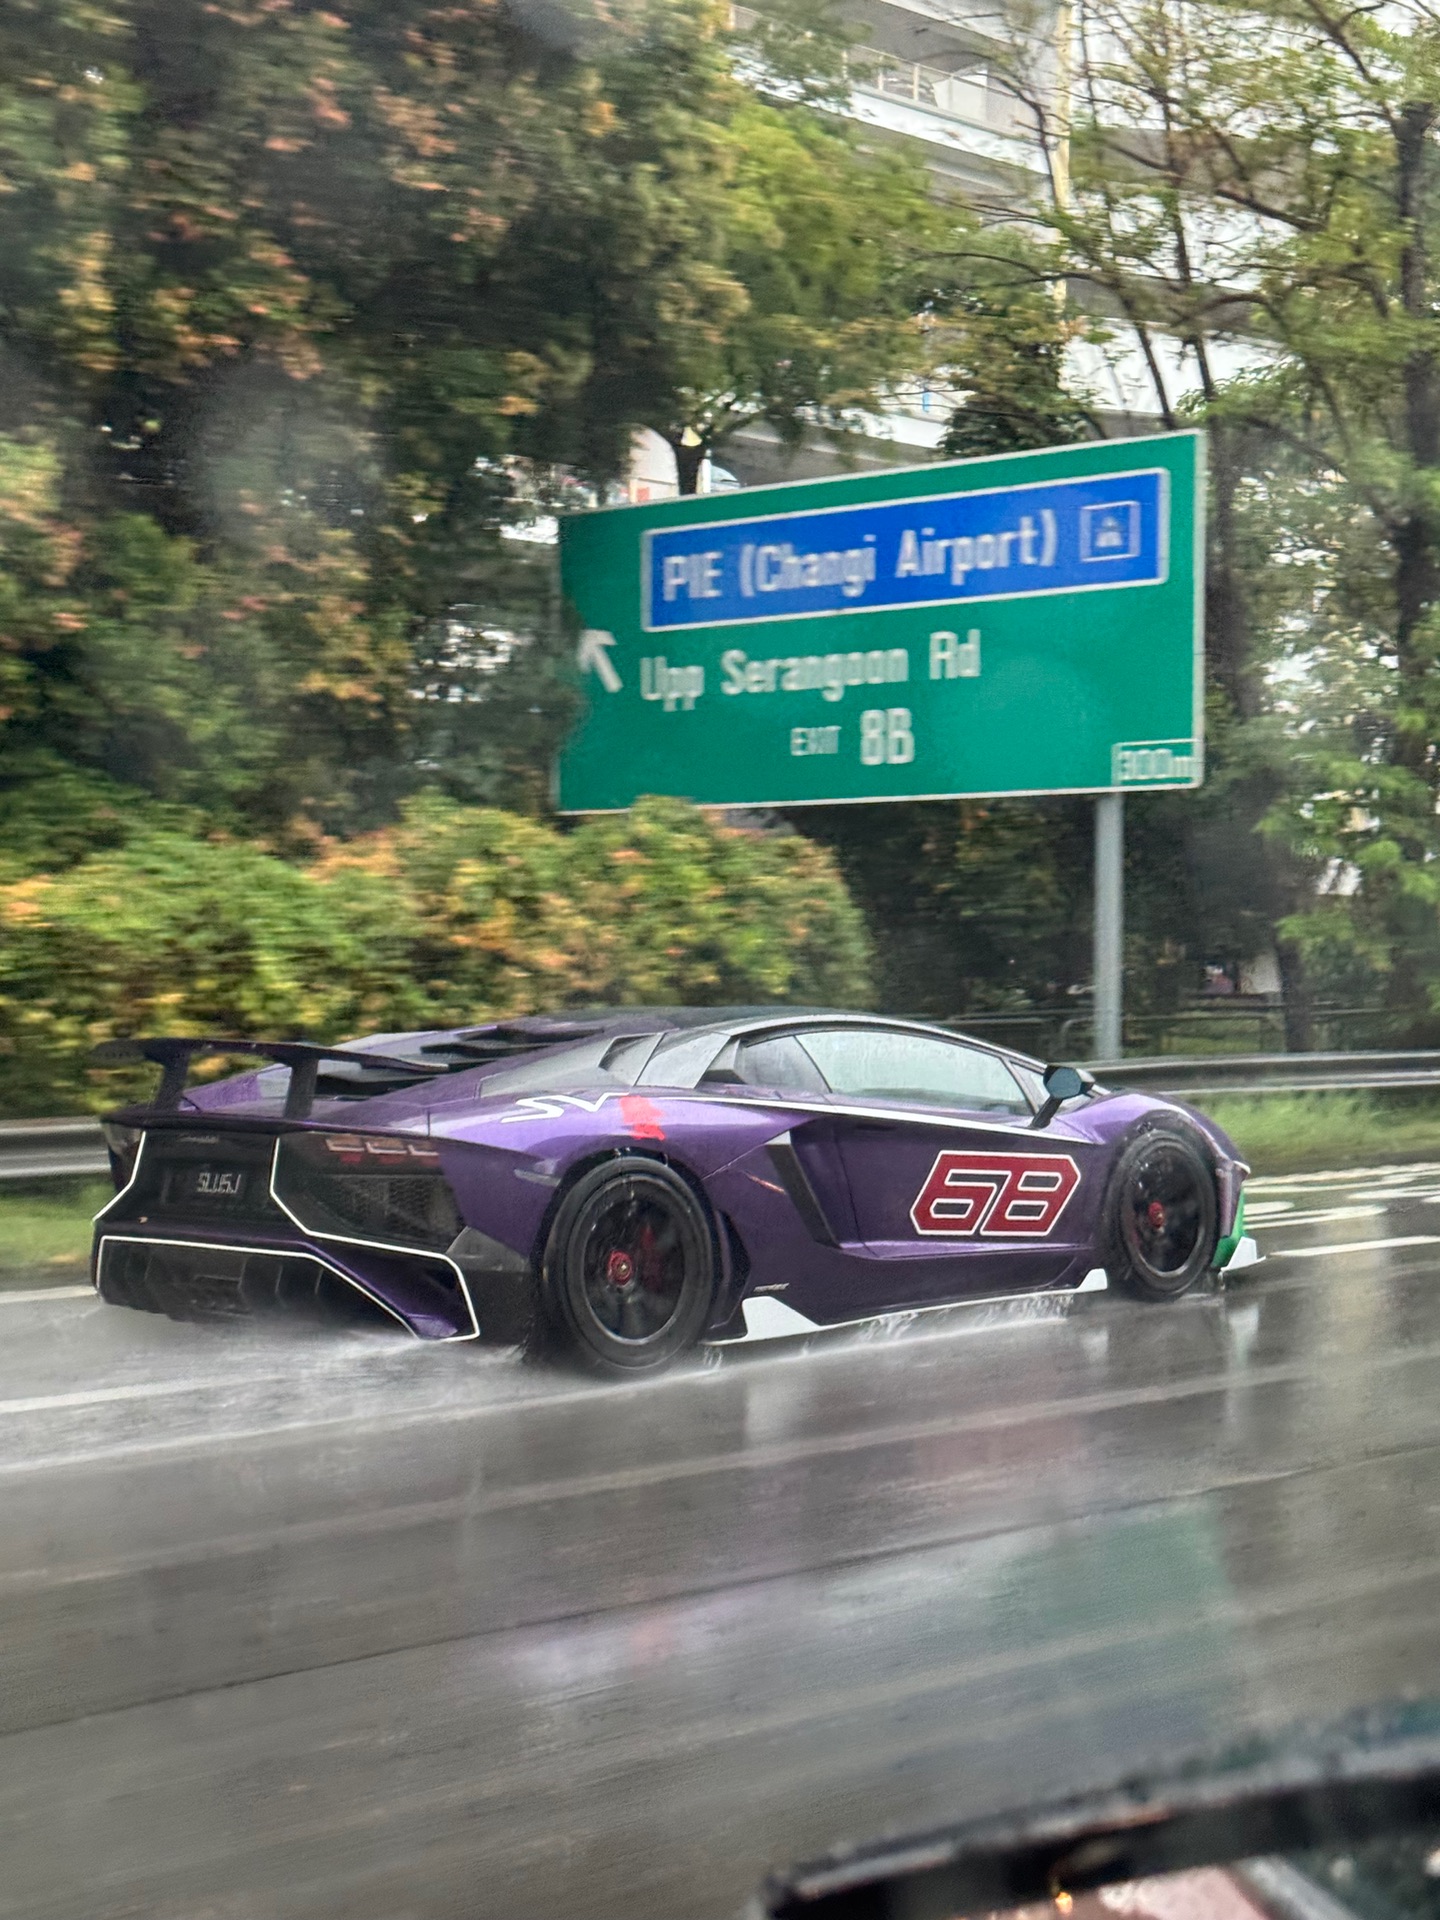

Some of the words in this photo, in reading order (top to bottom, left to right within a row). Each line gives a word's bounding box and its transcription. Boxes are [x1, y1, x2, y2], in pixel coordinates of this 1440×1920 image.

[663, 551, 722, 601] PIE
[740, 533, 876, 598] (Changi
[895, 509, 1057, 586] Airport)
[640, 656, 704, 712] Upp
[720, 649, 908, 702] Serangoon
[929, 629, 981, 680] Rd
